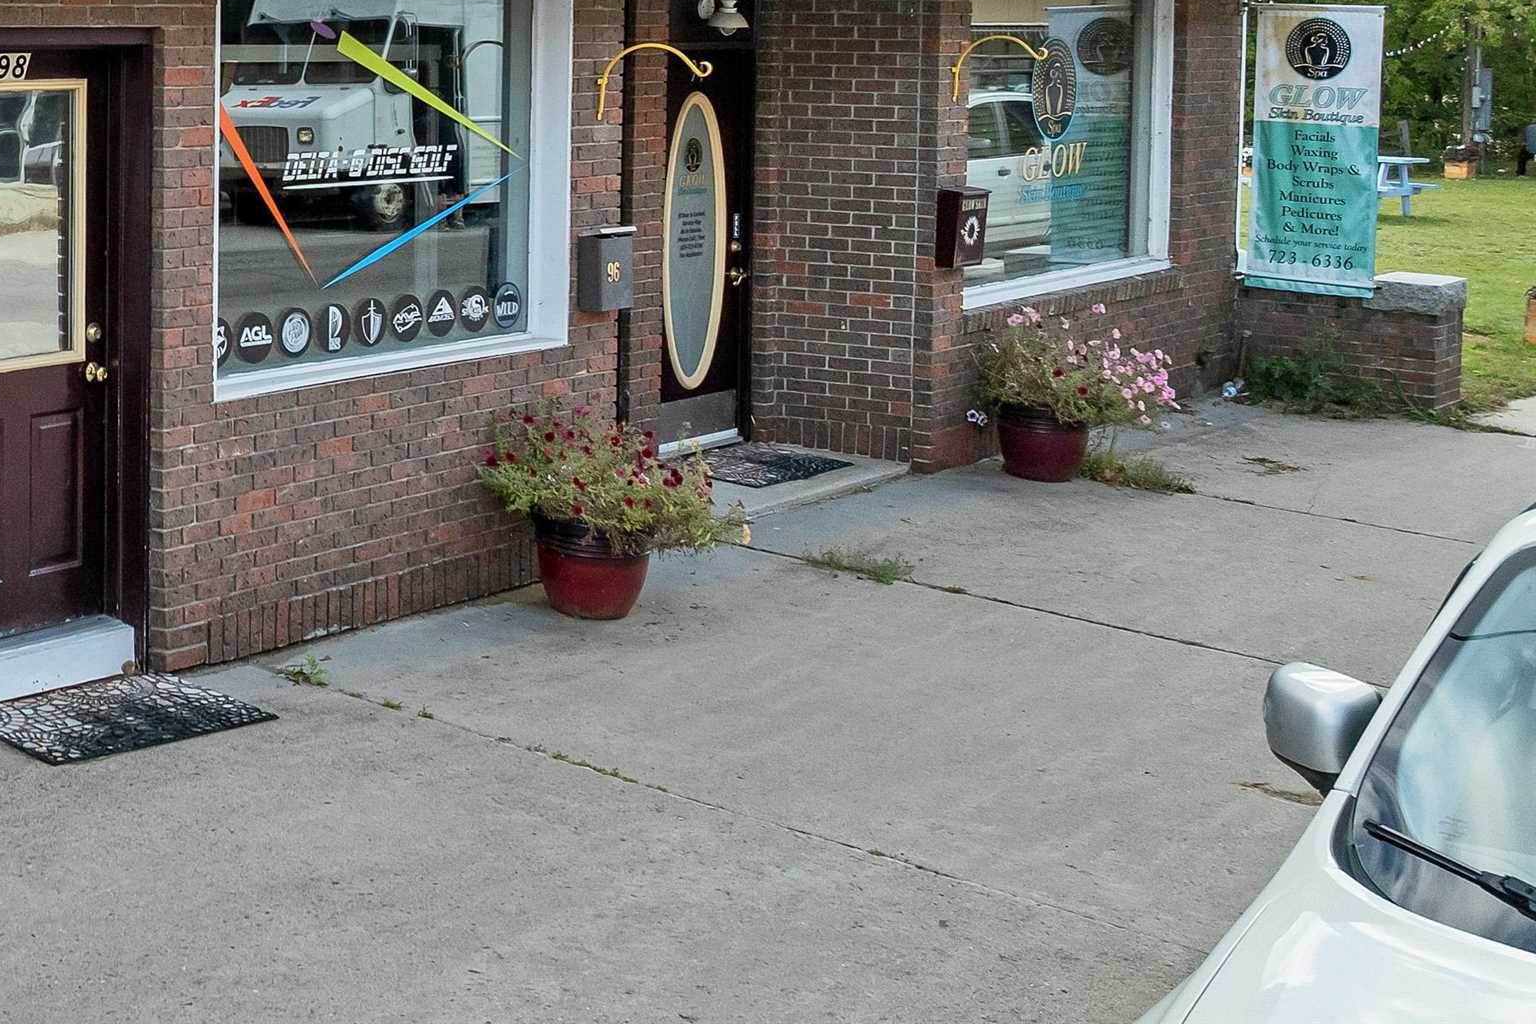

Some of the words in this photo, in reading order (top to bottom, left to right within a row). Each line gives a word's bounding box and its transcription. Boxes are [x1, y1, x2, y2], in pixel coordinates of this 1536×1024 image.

[1307, 67, 1328, 79] Spa
[1268, 83, 1368, 110] GLOW
[1268, 106, 1298, 120] Skin
[1302, 108, 1364, 125] Boutique
[1294, 129, 1336, 143] Facials
[366, 147, 411, 177] DISC
[409, 144, 458, 174] GOLF
[1290, 144, 1339, 161] Waxing
[1023, 142, 1087, 181] GLOW
[1267, 158, 1298, 173] Body
[1302, 160, 1344, 176] Wraps
[1347, 164, 1361, 176] &
[1292, 175, 1334, 189] Scrubs
[1279, 190, 1346, 205] Manicures
[1281, 205, 1343, 221] Pedicures
[1283, 221, 1295, 233] &
[1301, 222, 1339, 236] More!
[1292, 239, 1312, 247] your
[1314, 241, 1341, 250] service
[1344, 243, 1367, 253] today
[607, 261, 621, 283] 96
[496, 301, 519, 317] WILD
[240, 325, 272, 344] AGL
